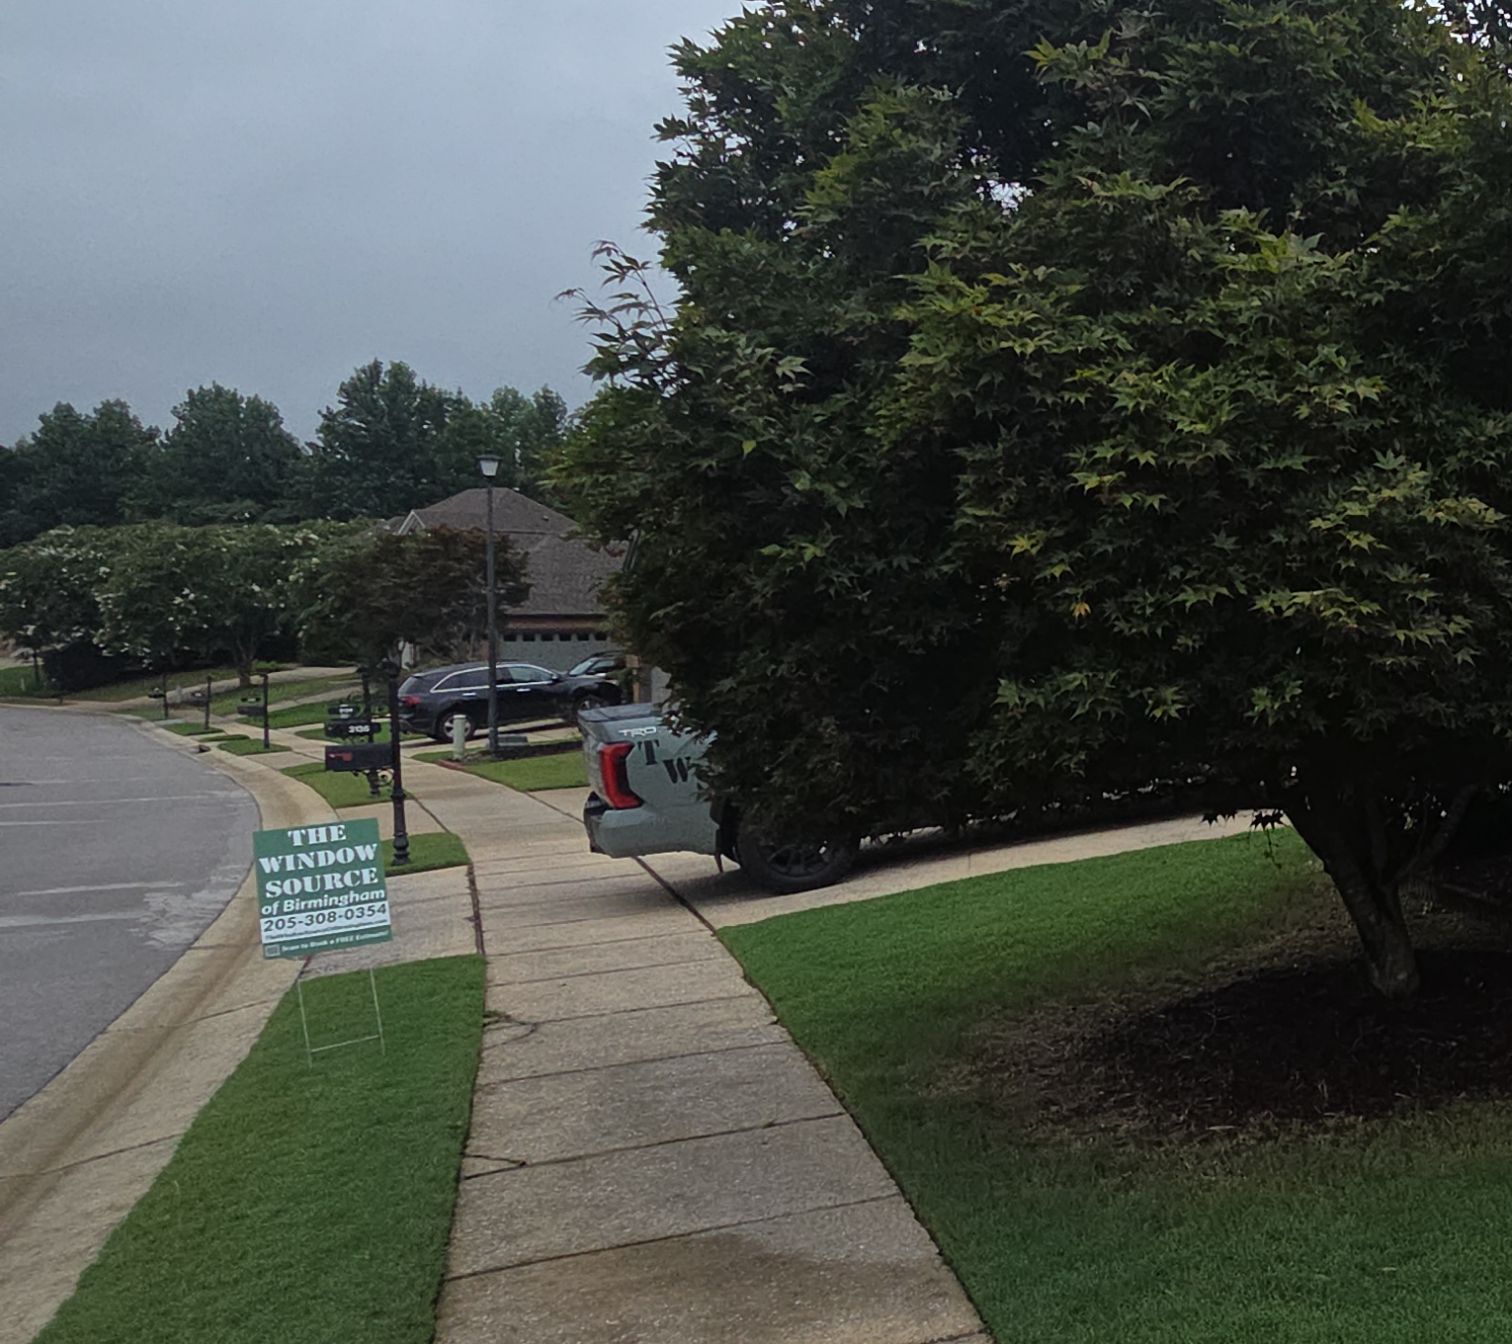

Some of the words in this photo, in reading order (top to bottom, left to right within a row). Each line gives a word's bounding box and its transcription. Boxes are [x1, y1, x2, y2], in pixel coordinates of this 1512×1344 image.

[288, 824, 347, 847] THE
[258, 843, 378, 874] WINDOW
[265, 867, 379, 898] SOURCE
[261, 900, 280, 916] of
[282, 889, 385, 913] Birmingham
[263, 903, 387, 932] 205-308-0354
